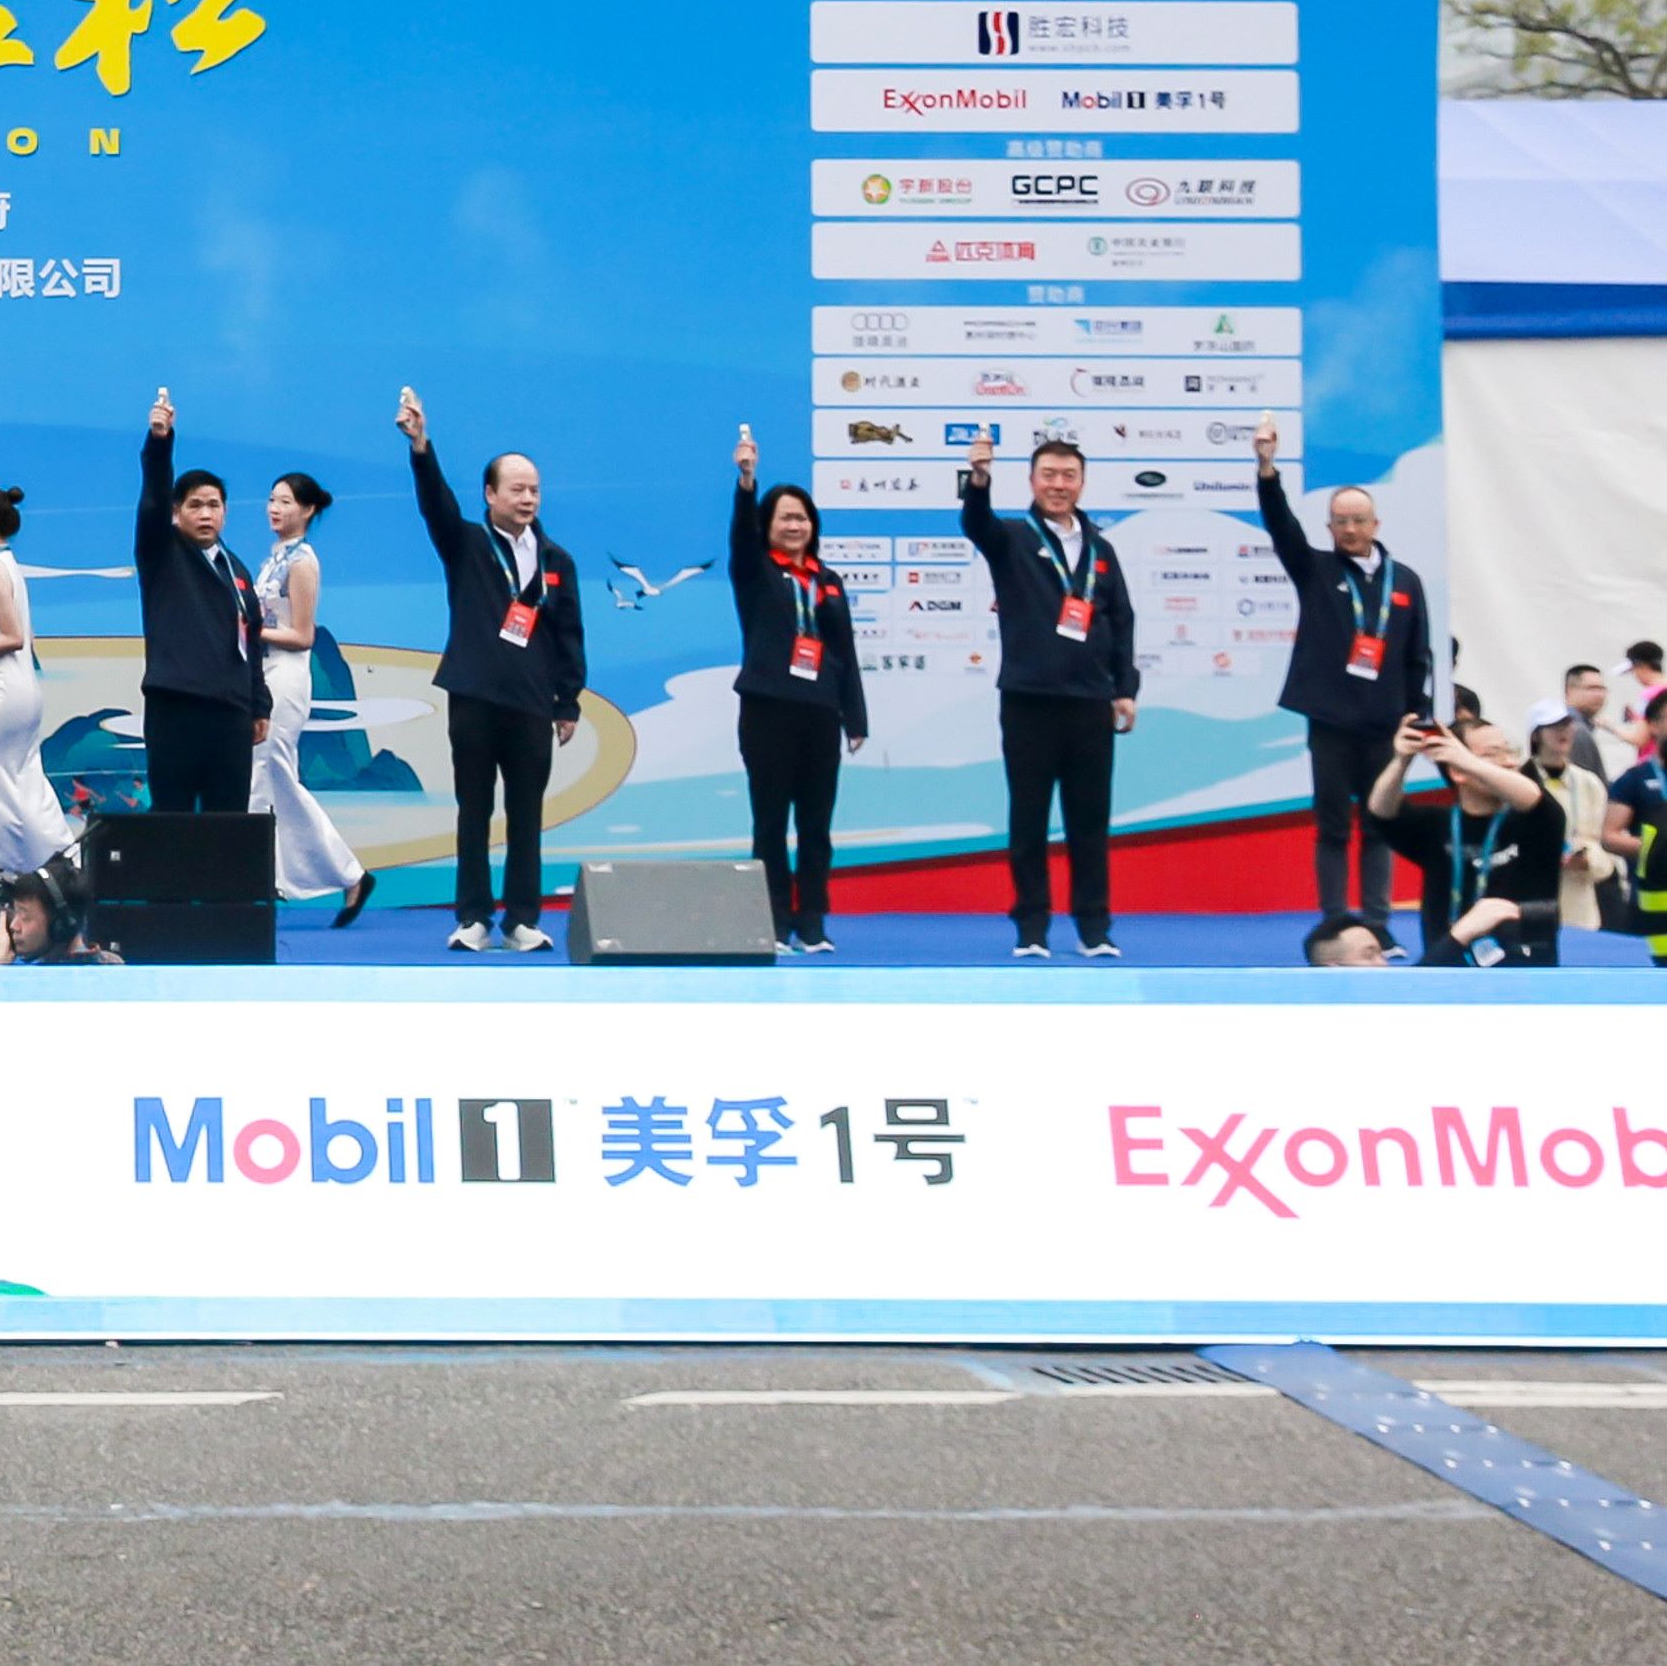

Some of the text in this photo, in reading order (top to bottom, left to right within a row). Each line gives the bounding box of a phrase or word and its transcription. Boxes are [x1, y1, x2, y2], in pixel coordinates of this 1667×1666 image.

[883, 88, 1027, 116] ExxonMobil
[1062, 91, 1122, 110] Mobil
[1012, 175, 1099, 195] GCPC
[133, 1096, 433, 1184] Mobil
